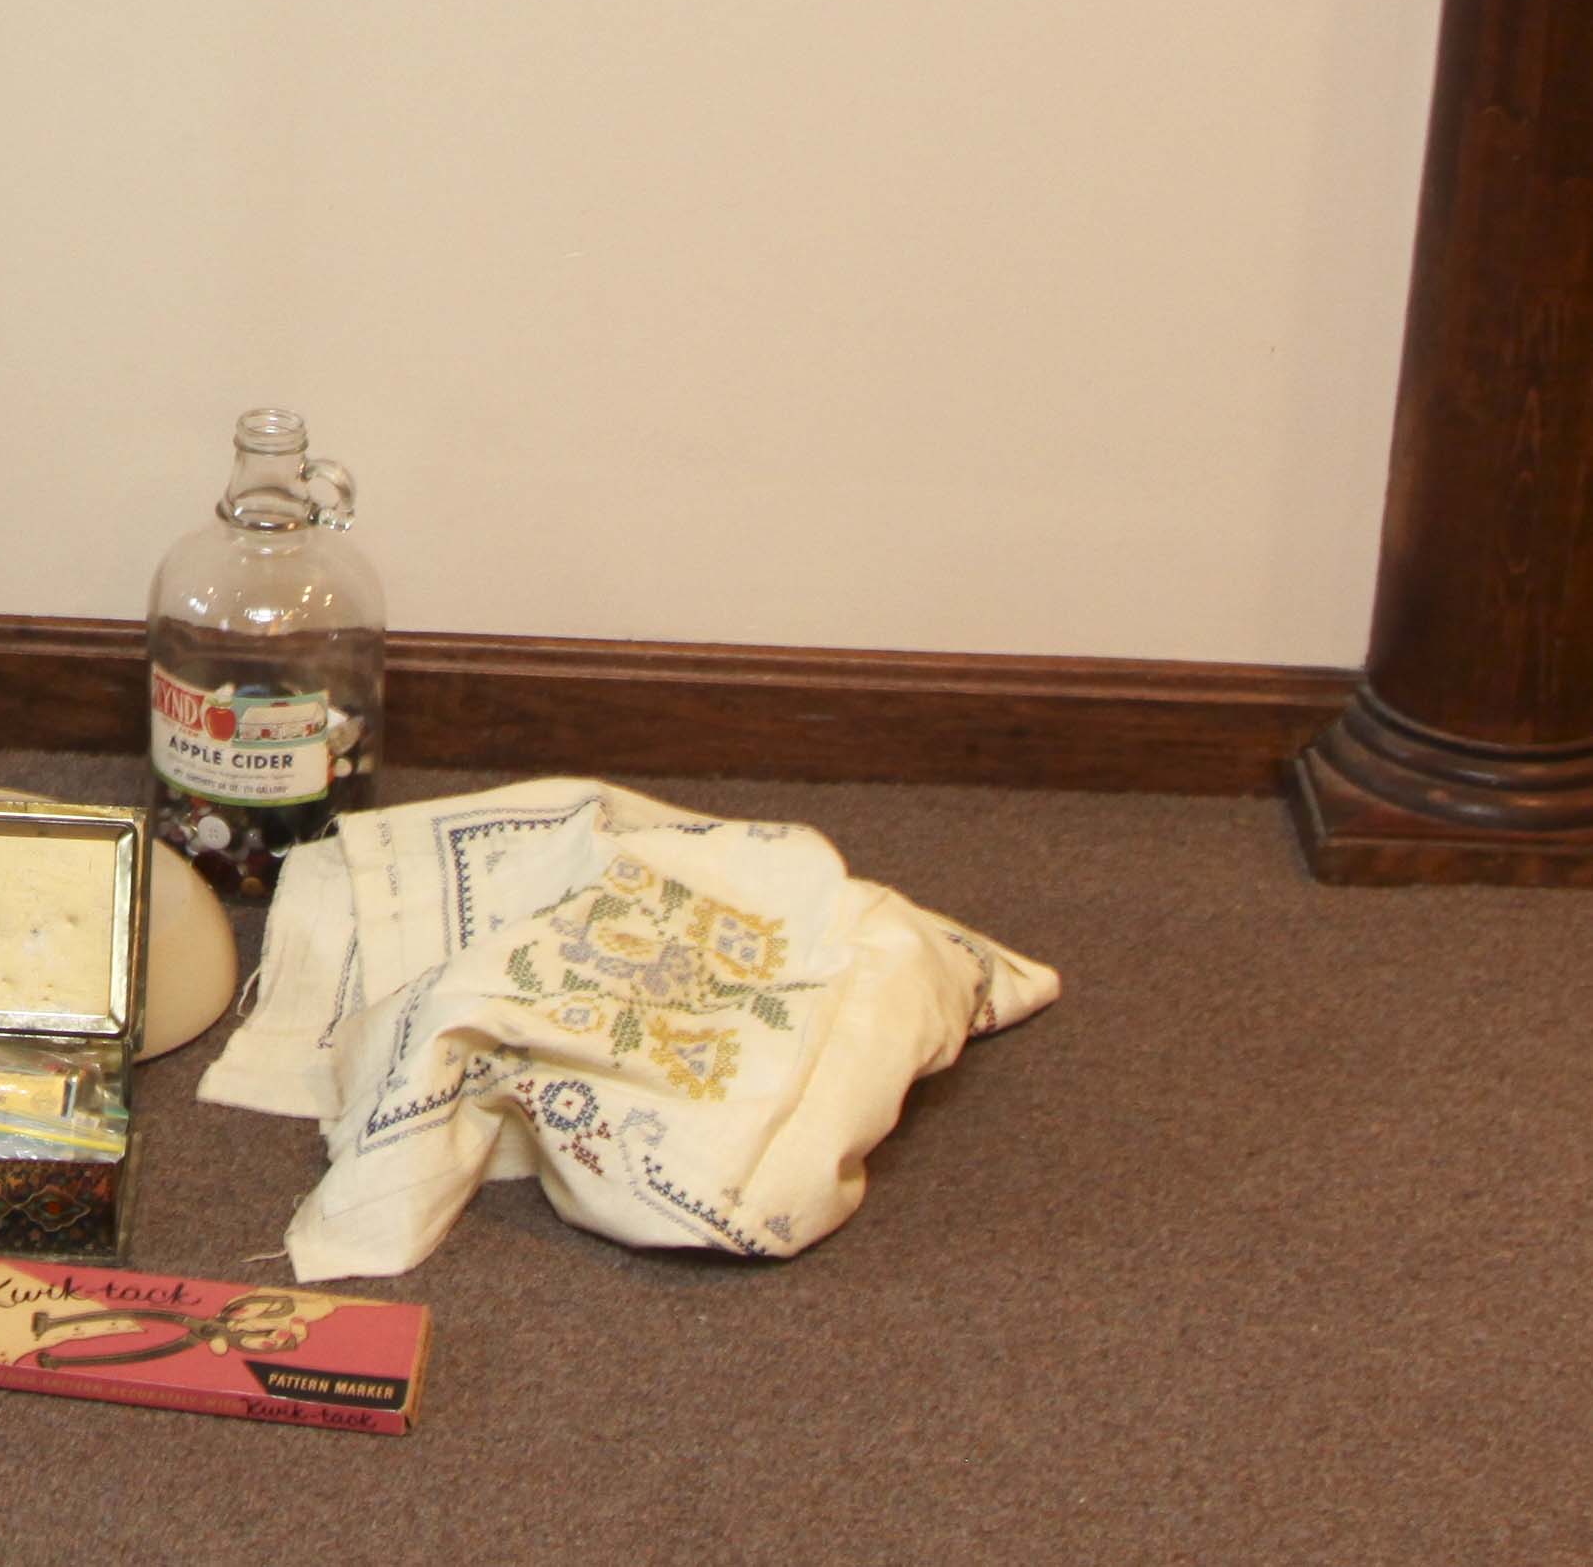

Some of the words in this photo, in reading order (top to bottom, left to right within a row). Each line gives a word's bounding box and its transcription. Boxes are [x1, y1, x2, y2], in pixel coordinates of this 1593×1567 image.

[168, 736, 222, 766] APPLE
[231, 753, 294, 770] CIDER
[267, 1371, 329, 1394] PATTERN
[333, 1381, 397, 1401] MARKER
